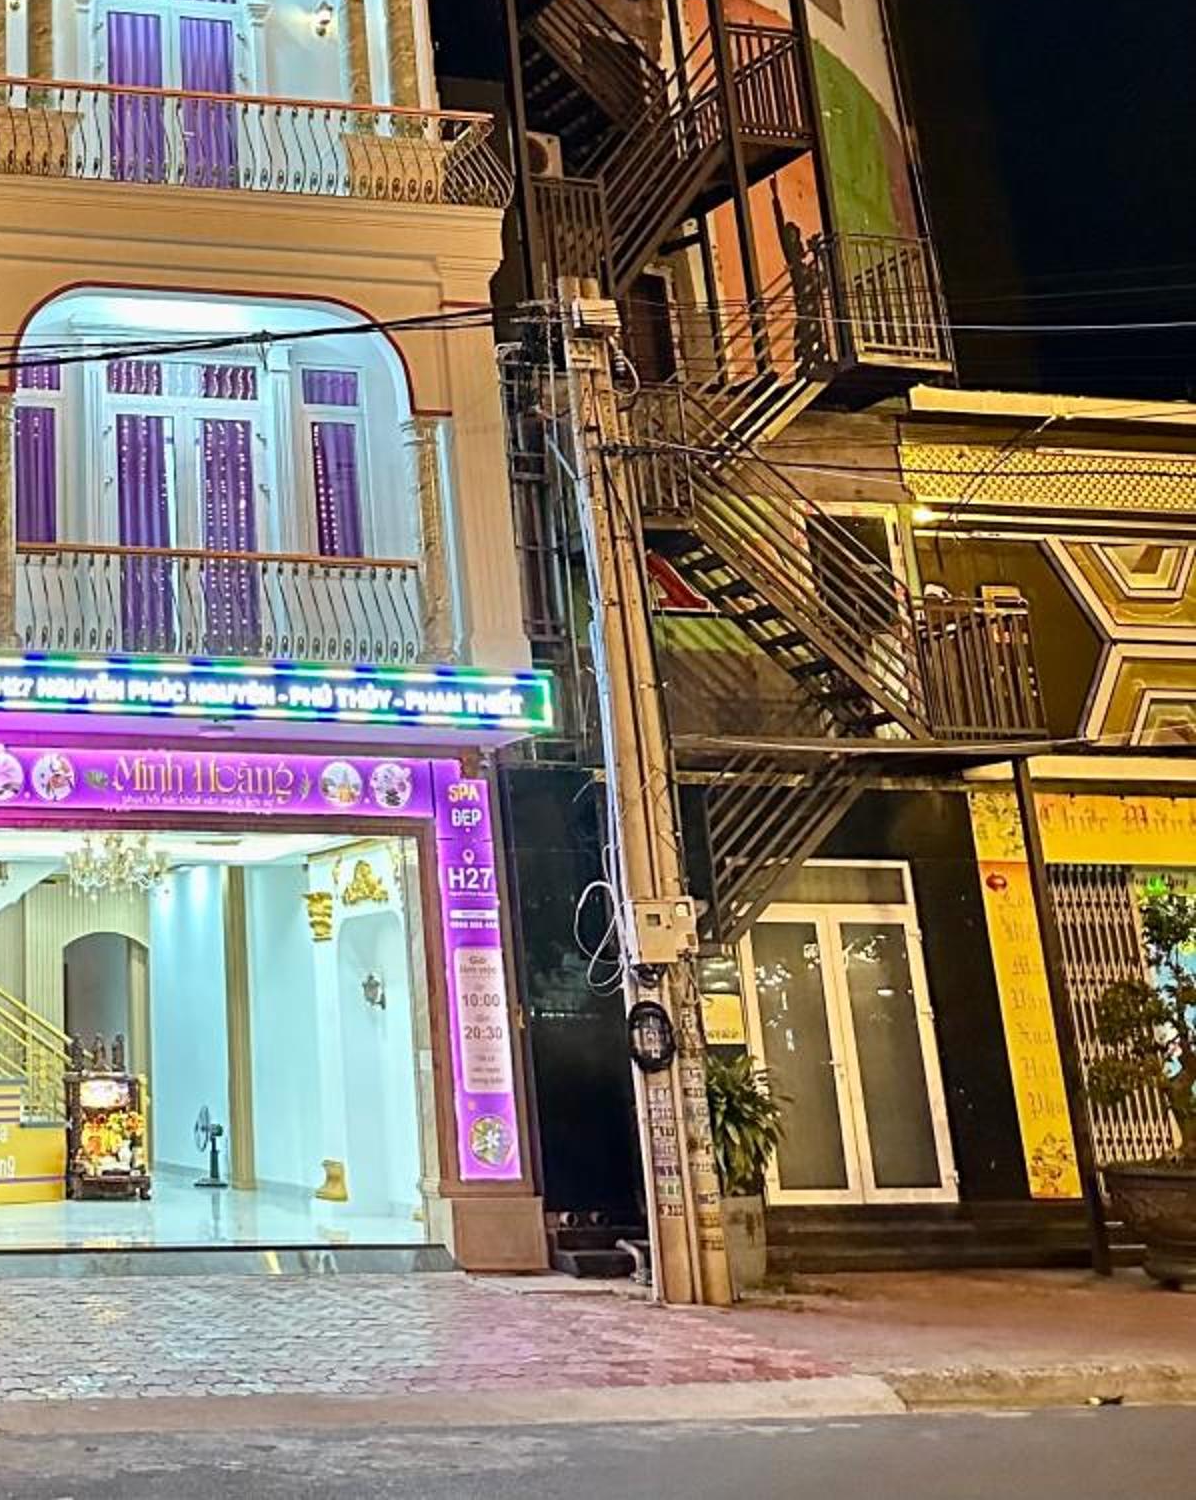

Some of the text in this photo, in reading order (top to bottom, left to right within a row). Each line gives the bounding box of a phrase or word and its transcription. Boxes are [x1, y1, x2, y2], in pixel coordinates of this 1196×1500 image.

[128, 676, 187, 702] PHÚC
[405, 687, 463, 714] PHAN
[112, 754, 295, 804] Minh Hoàng
[448, 783, 481, 803] SPA
[451, 808, 482, 833] ĐẸP
[447, 867, 494, 889] H27
[464, 1025, 503, 1040] 20:30
